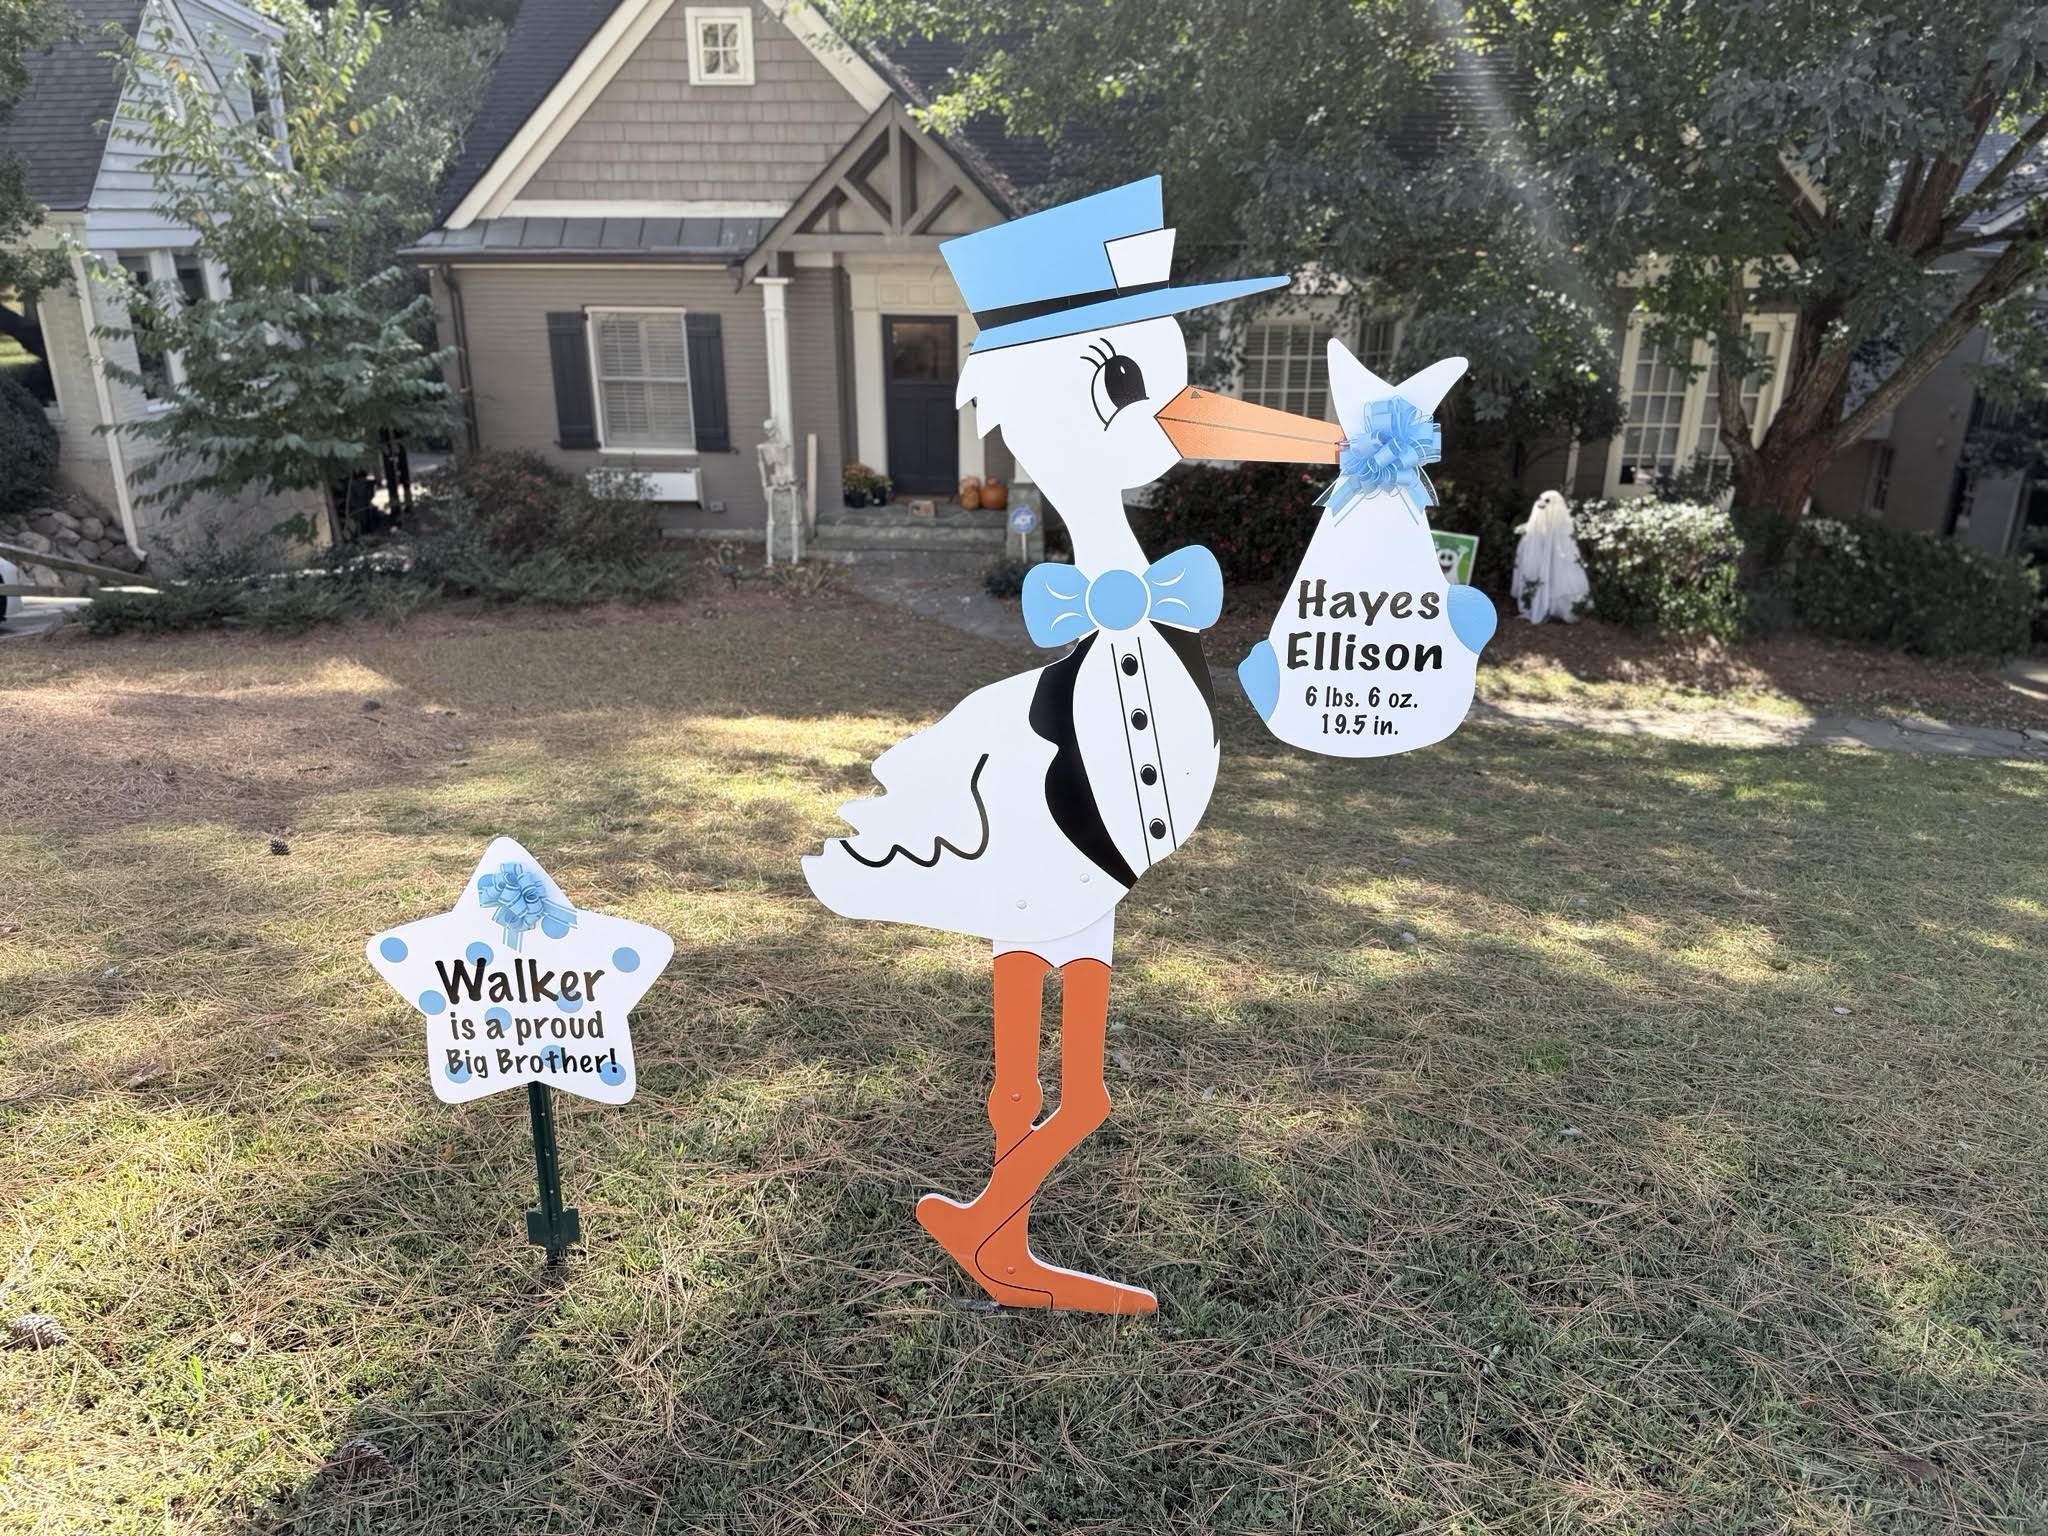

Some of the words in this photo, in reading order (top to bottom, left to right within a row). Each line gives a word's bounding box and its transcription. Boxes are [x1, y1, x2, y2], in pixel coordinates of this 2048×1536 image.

[1298, 579, 1440, 626] Hayes
[1287, 631, 1442, 672] Ellison
[1305, 686, 1317, 707] 6
[1326, 686, 1359, 707] lbs.
[1369, 687, 1380, 707] 6
[1389, 692, 1418, 708] oz.
[1322, 714, 1367, 735] 19.5
[1374, 716, 1398, 735] in.
[435, 957, 604, 1004] Walker
[450, 1012, 475, 1040] is
[486, 1017, 504, 1039] a
[516, 1010, 604, 1045] proud
[446, 1048, 488, 1078] Big
[496, 1047, 617, 1073] Brother!
